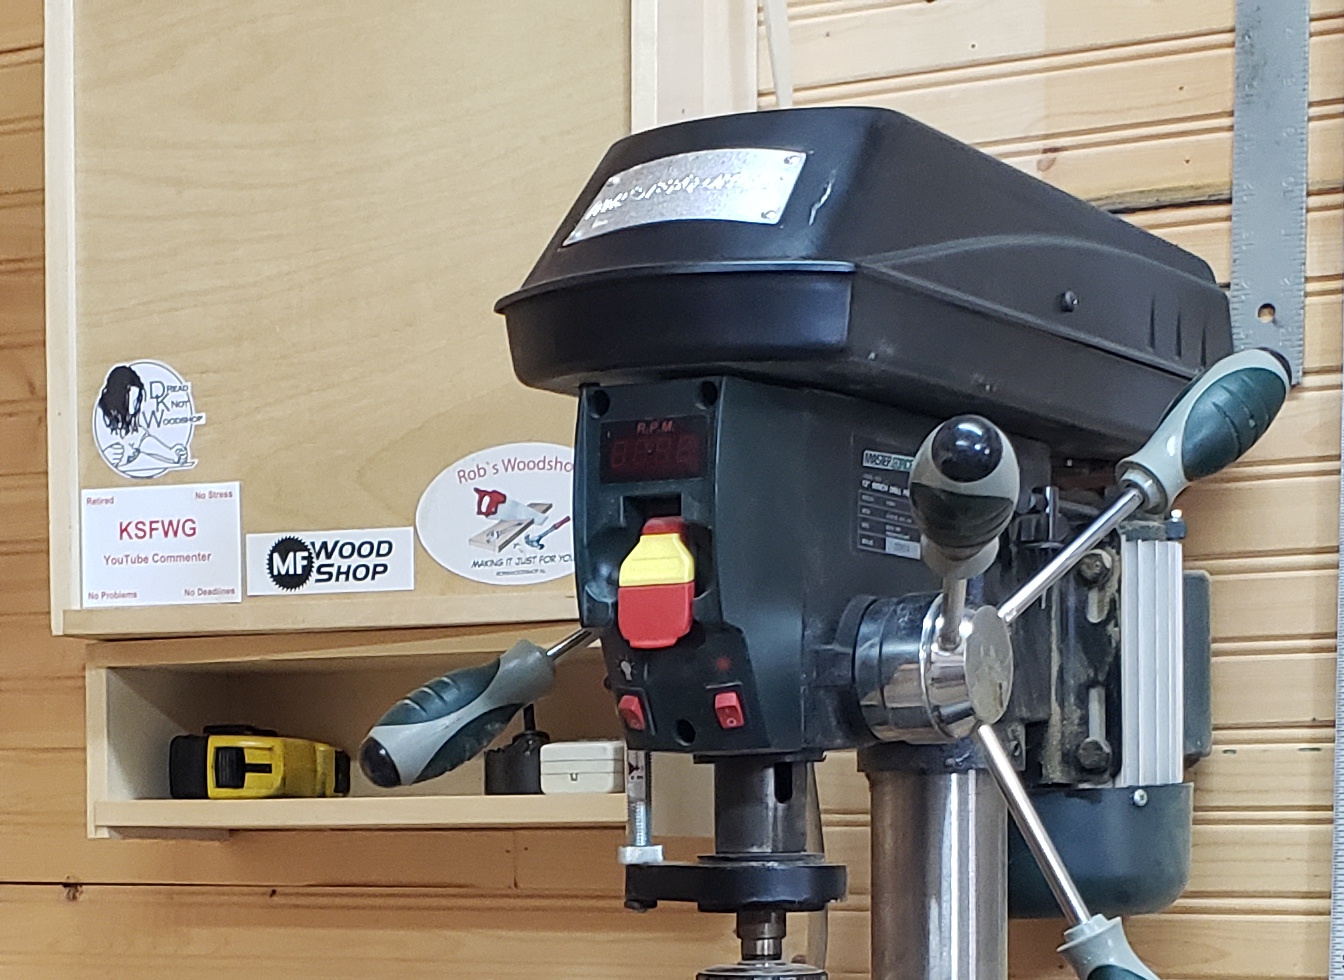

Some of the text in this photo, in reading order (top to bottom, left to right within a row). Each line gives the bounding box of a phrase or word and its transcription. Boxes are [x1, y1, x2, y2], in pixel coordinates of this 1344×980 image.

[501, 455, 574, 473] Woodsho
[87, 497, 114, 505] Retired
[195, 490, 233, 499] No Stress
[119, 519, 197, 540] KSFWG
[310, 540, 393, 560] WOOD
[104, 552, 212, 565] YouTube Commenter
[272, 551, 309, 576] MF
[471, 558, 504, 569] MAKING
[506, 557, 514, 566] IT
[515, 556, 537, 566] JUST
[538, 554, 557, 564] FOR
[315, 563, 388, 583] SHOP
[88, 591, 137, 600] No Problems
[184, 587, 235, 596] No Deadlines
